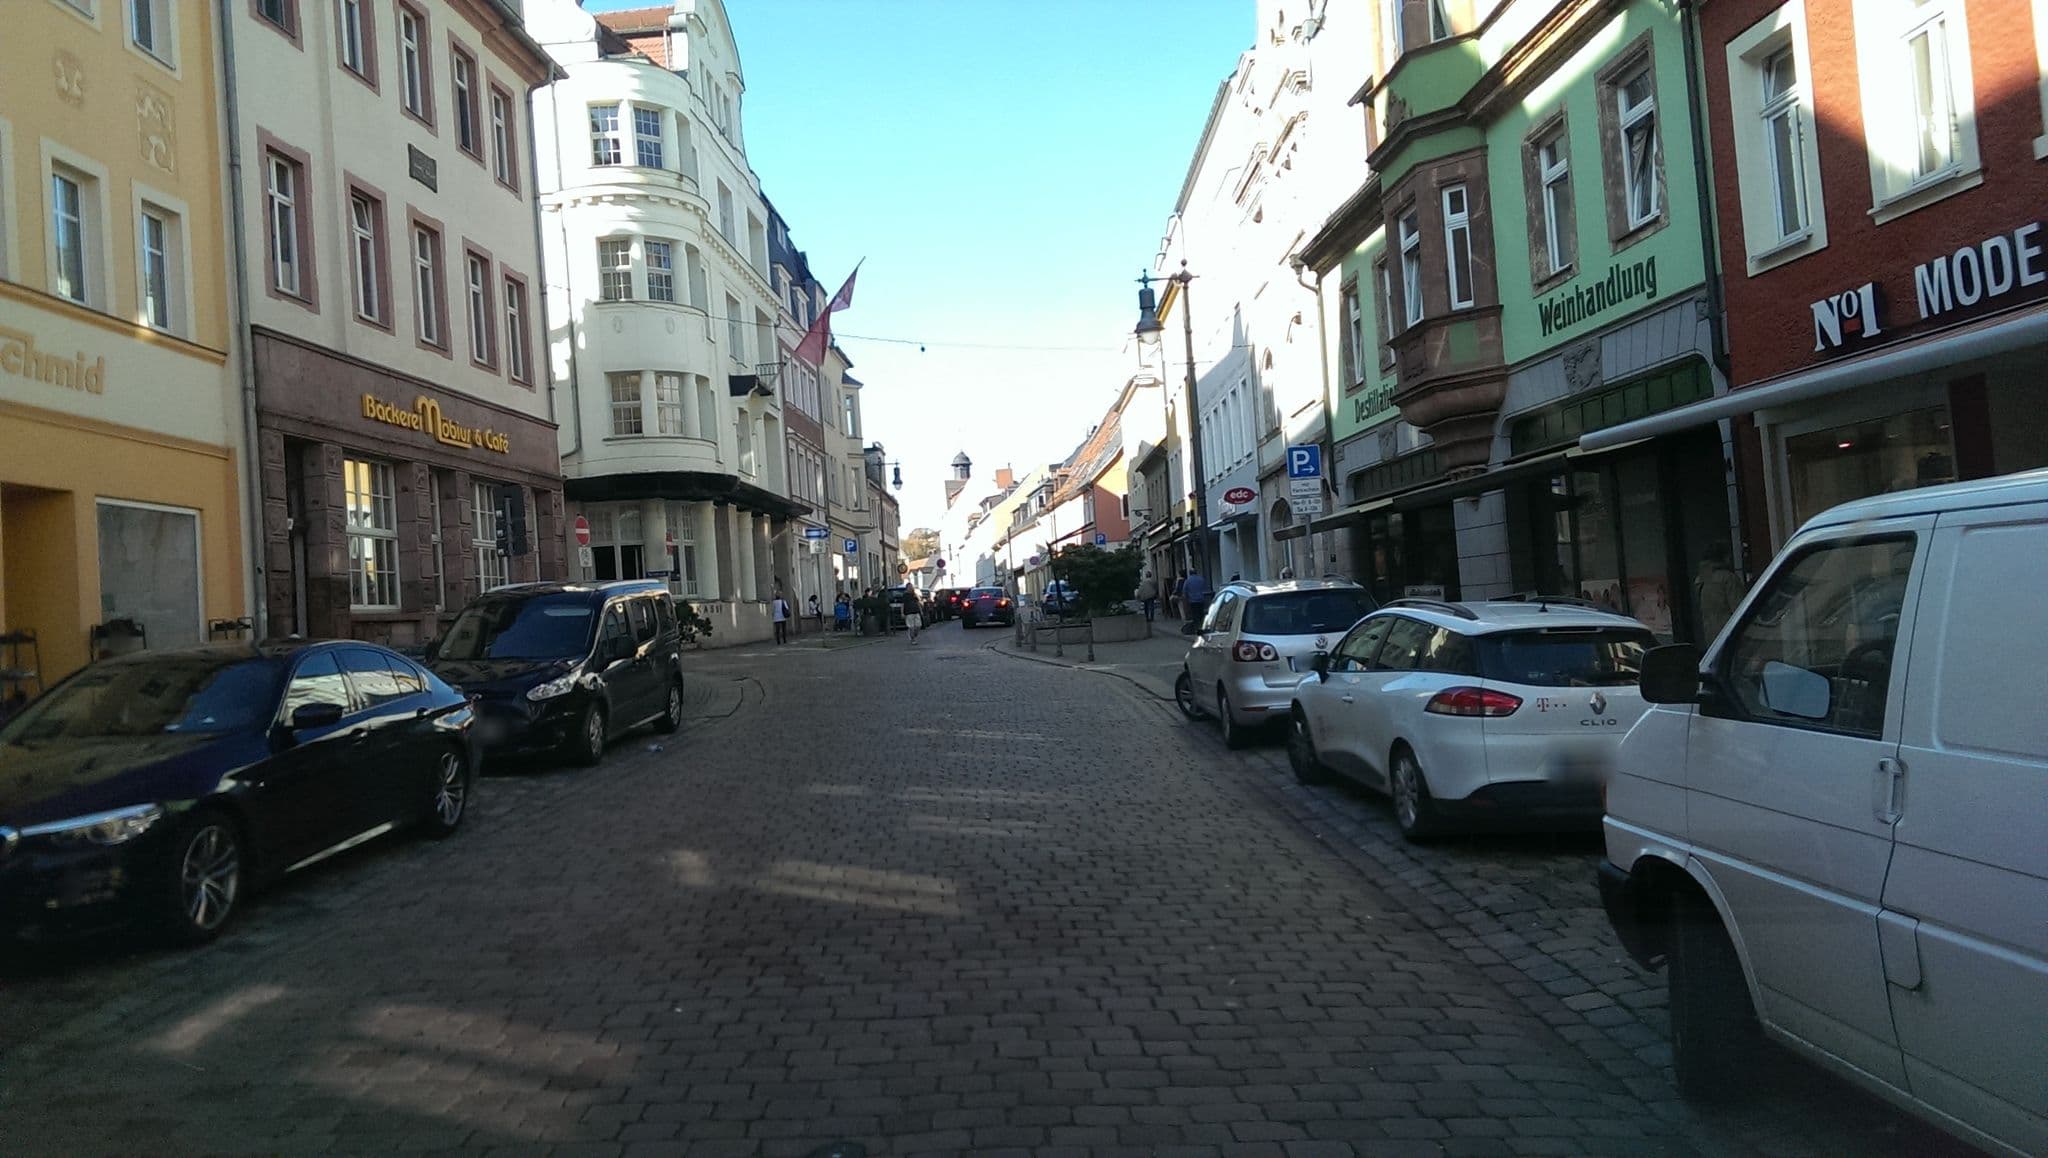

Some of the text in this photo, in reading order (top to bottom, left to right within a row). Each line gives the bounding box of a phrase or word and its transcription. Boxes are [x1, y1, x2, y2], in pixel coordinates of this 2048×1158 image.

[1538, 255, 1657, 337] Weinhandlung
[1914, 222, 2047, 320] MODE
[0, 326, 104, 395] chmid
[361, 393, 423, 431] Bäckerei
[415, 396, 472, 449] Möbius
[485, 425, 510, 454] Café
[1292, 450, 1310, 474] P
[1230, 490, 1249, 499] edc
[846, 541, 855, 551] P
